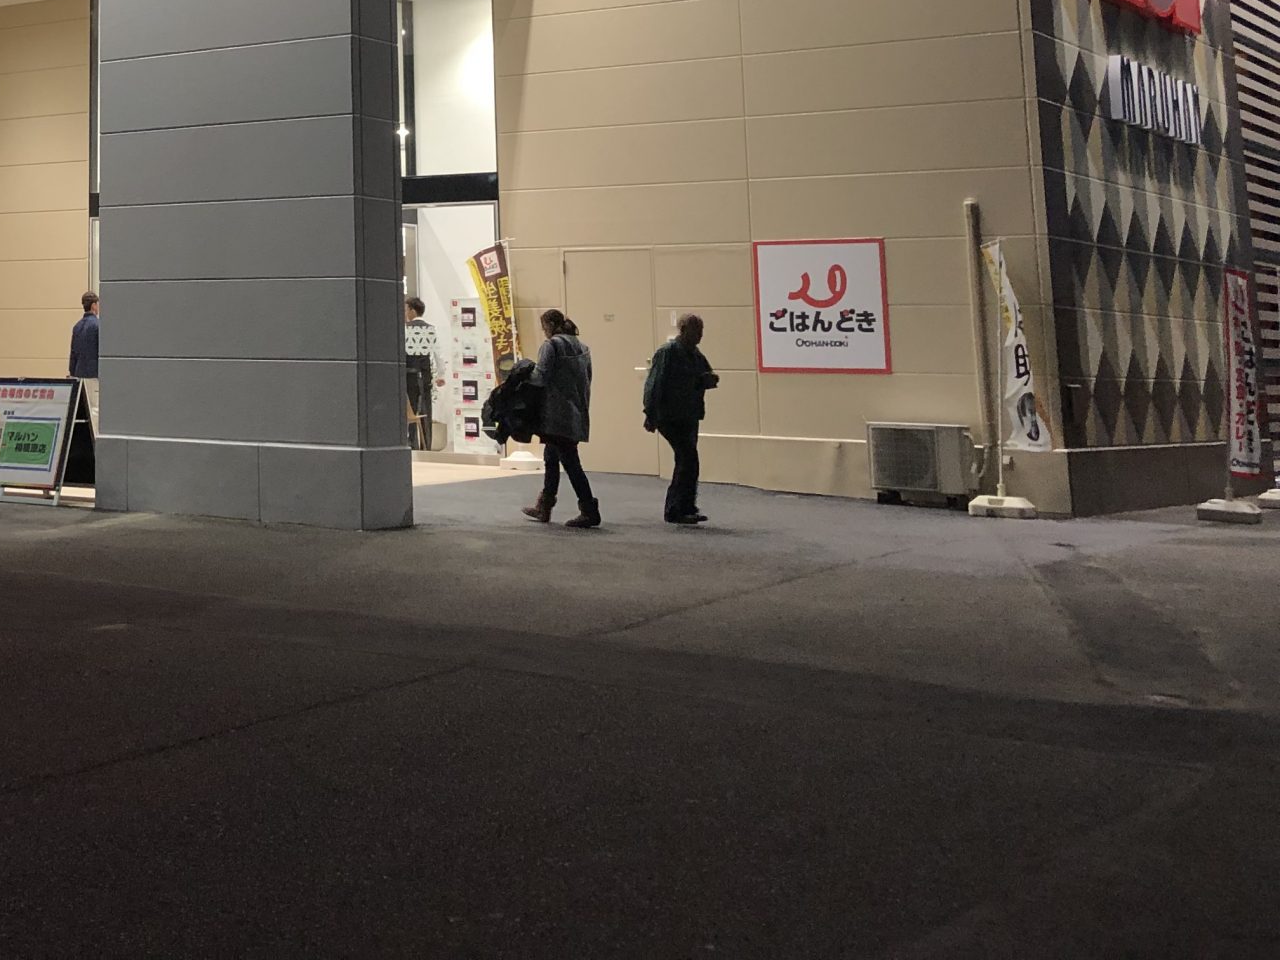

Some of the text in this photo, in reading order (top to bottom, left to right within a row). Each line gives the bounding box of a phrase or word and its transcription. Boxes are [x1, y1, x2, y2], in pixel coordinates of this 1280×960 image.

[768, 308, 877, 333] ごはんどき
[8, 431, 39, 442] マルハン
